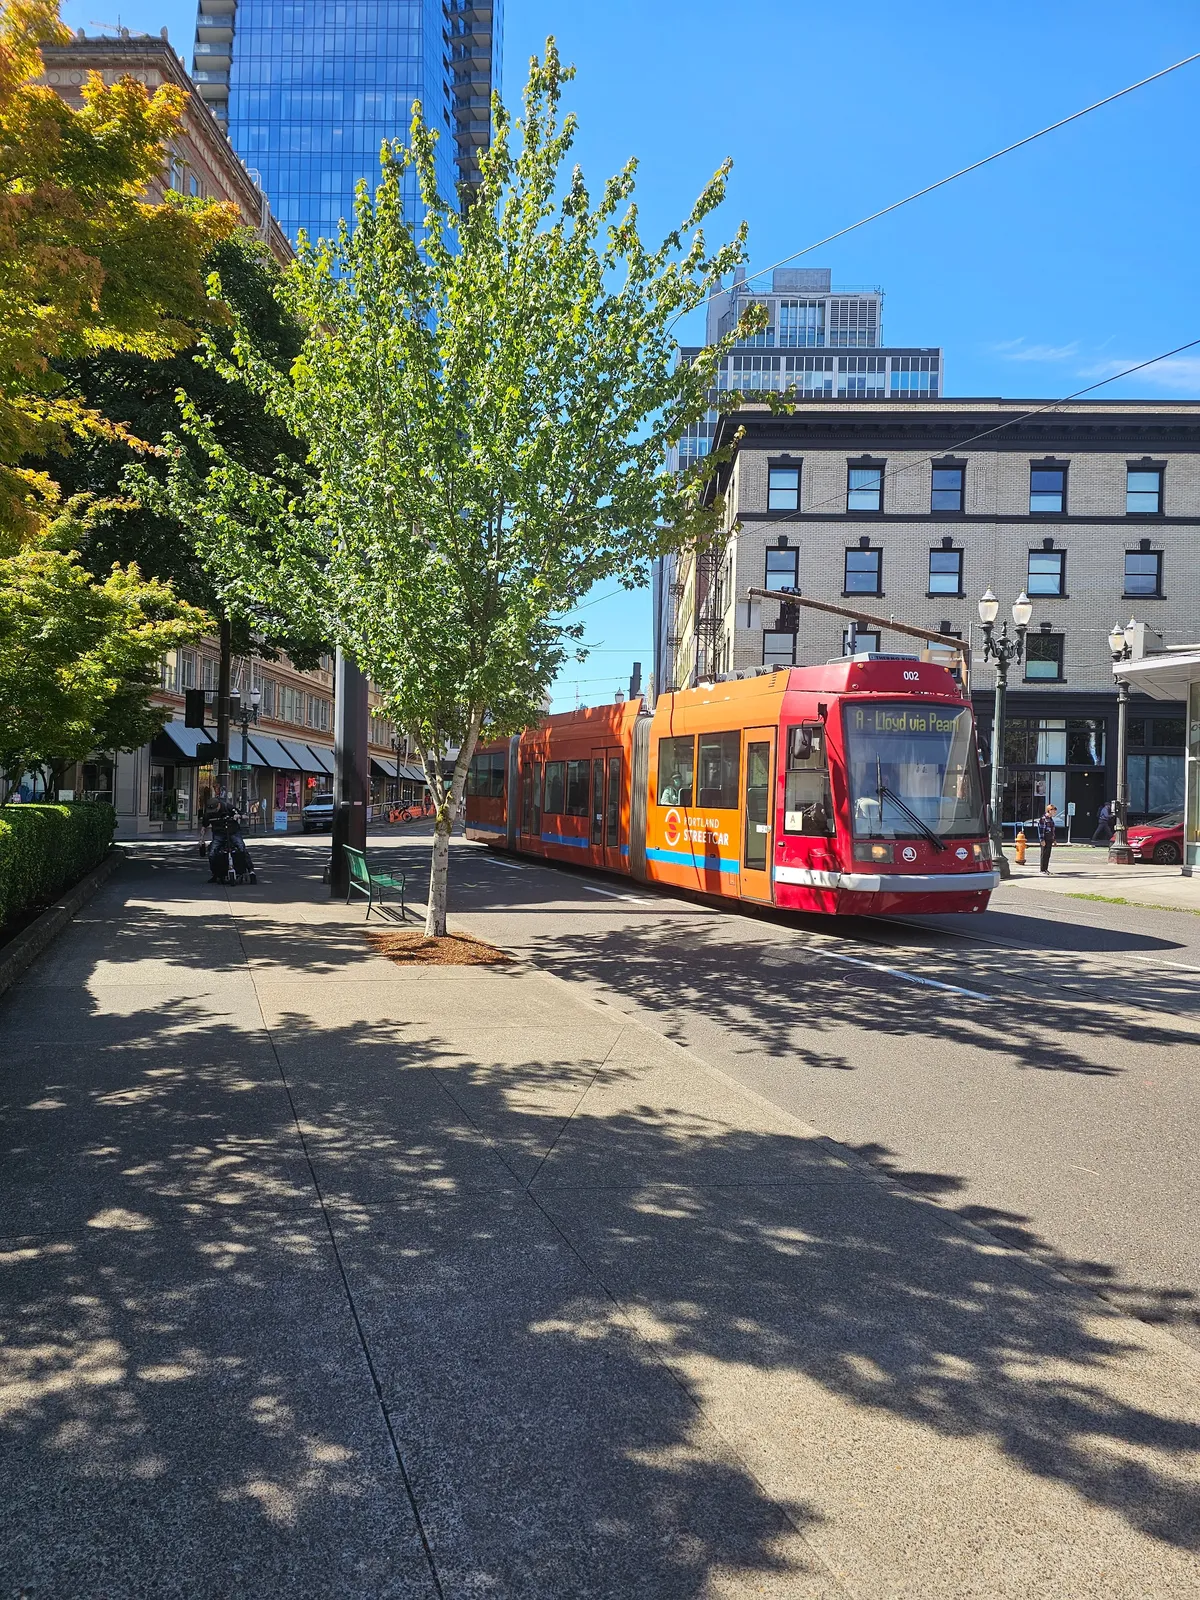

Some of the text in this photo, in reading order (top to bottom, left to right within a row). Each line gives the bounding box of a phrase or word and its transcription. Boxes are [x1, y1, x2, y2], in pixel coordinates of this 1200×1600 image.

[903, 671, 919, 680] 002
[856, 710, 864, 729] A
[875, 711, 906, 732] Lloyd
[909, 715, 926, 732] via
[929, 712, 960, 733] Pearl
[684, 817, 720, 829] PORTLAND
[790, 814, 796, 824] A
[683, 829, 729, 846] STREETCAR
